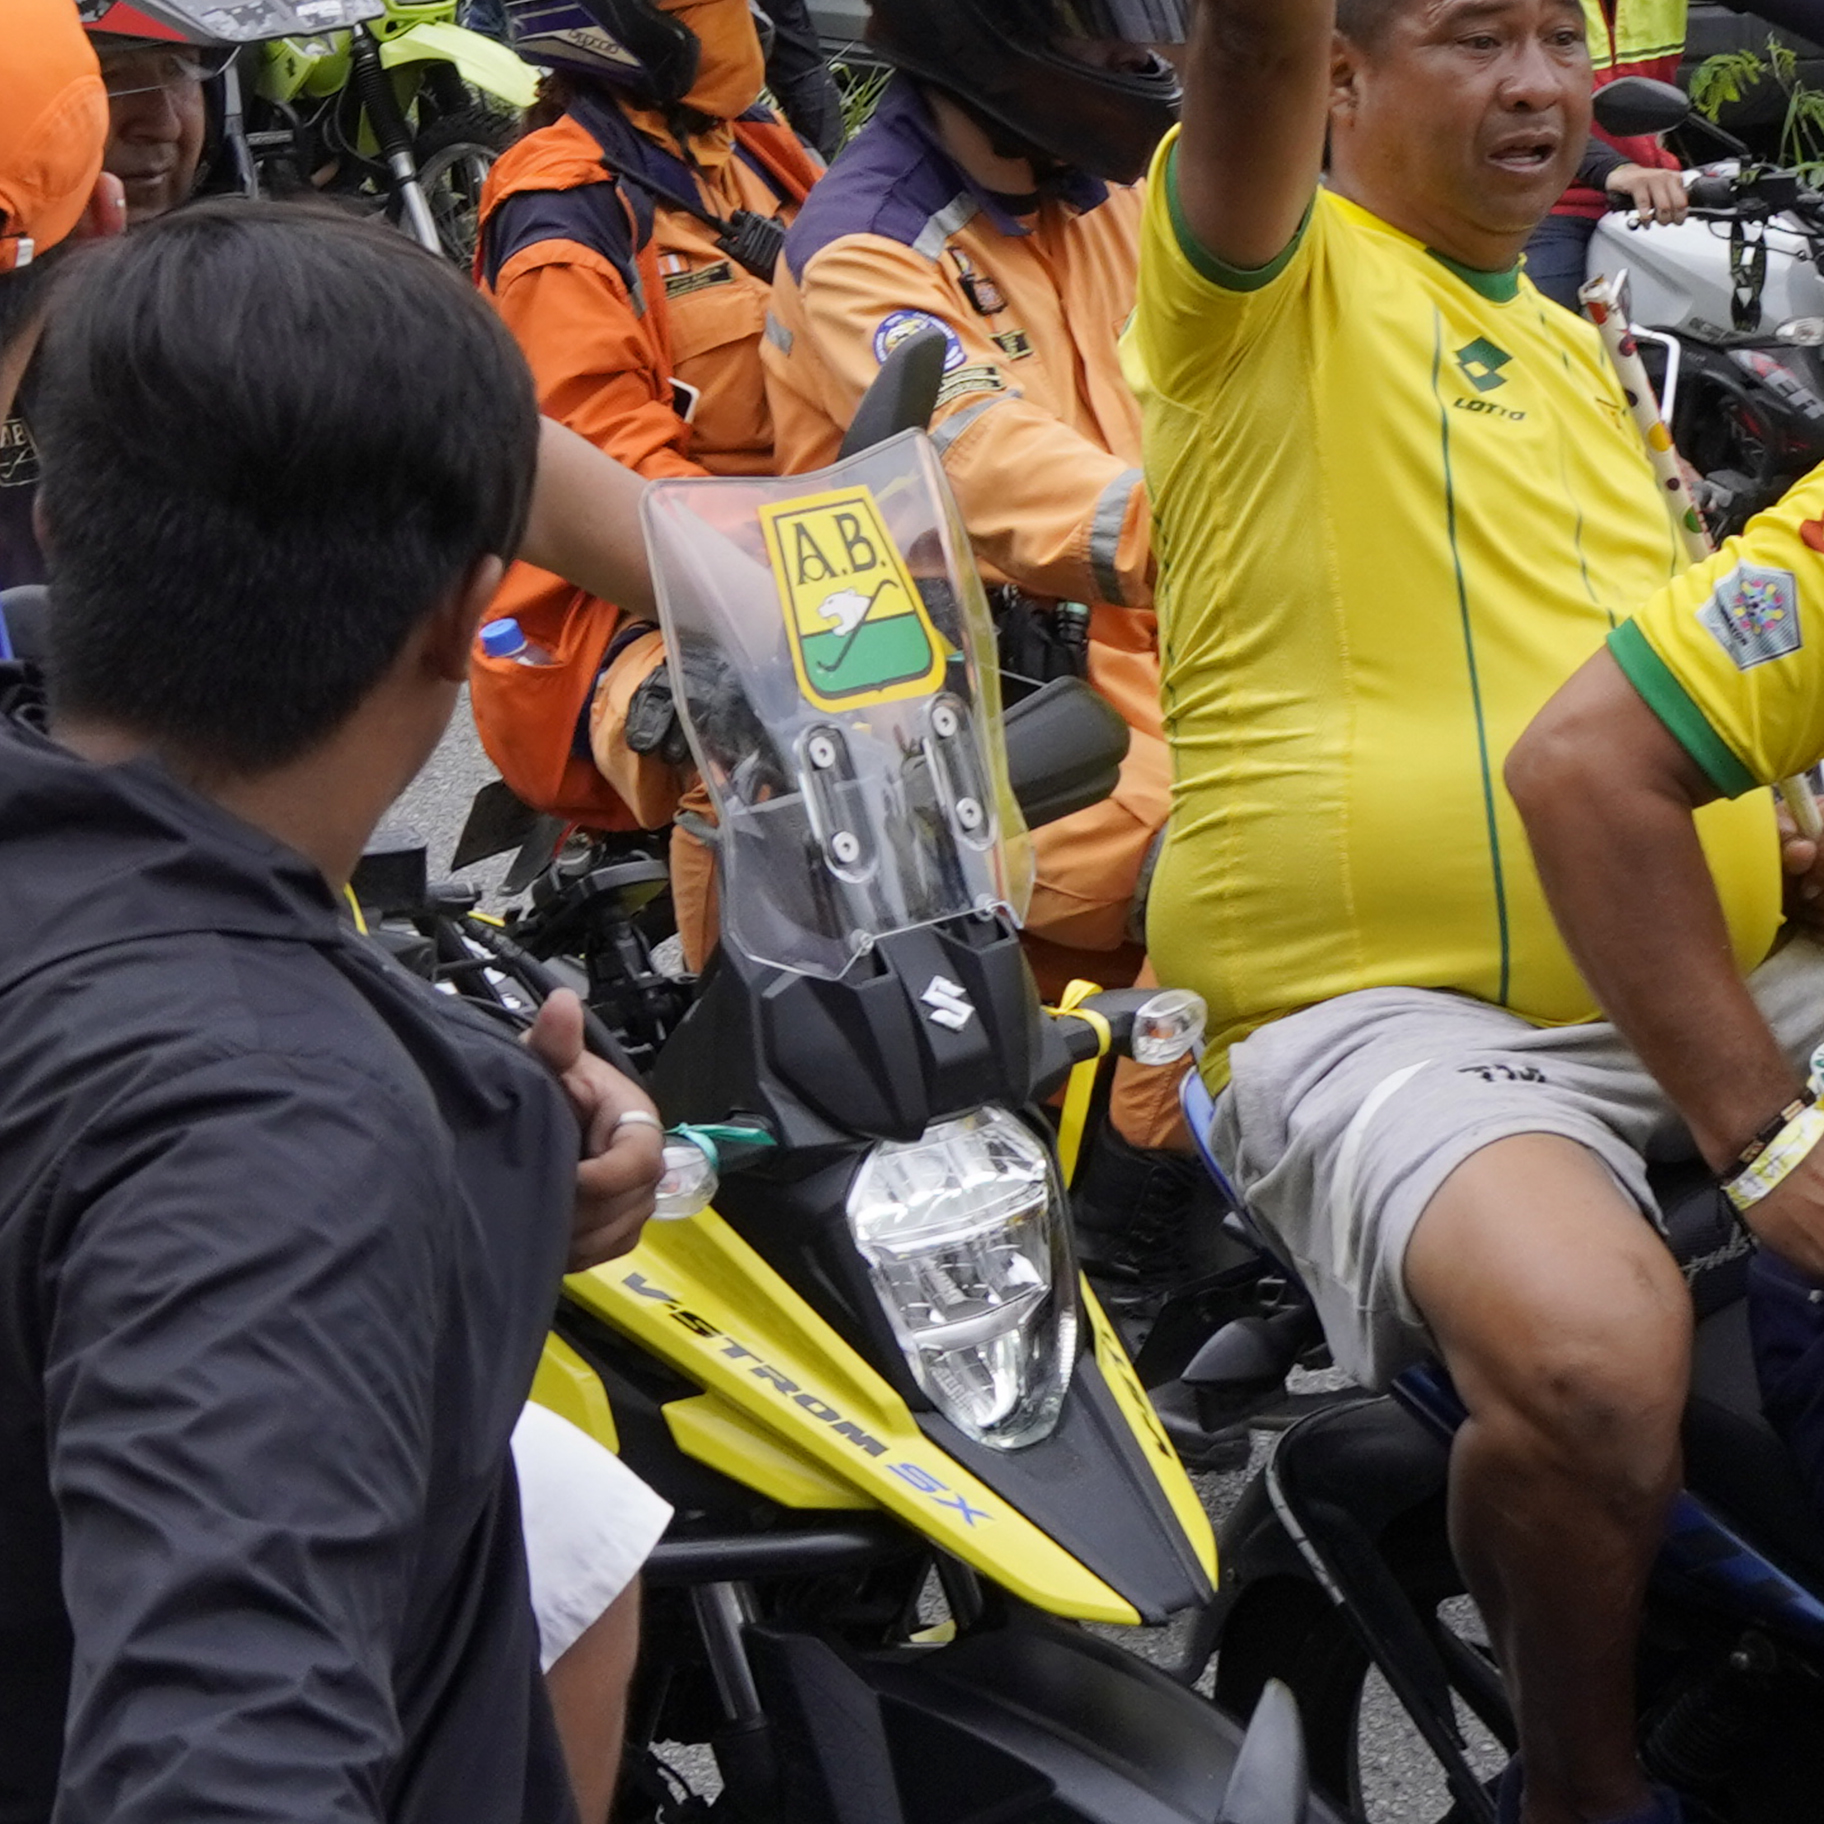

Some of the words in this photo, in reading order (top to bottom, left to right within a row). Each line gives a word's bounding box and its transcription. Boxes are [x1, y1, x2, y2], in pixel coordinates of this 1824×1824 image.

[1452, 396, 1527, 422] LOTTO
[619, 1270, 891, 1460] V-STROM
[882, 1461, 995, 1530] SX
